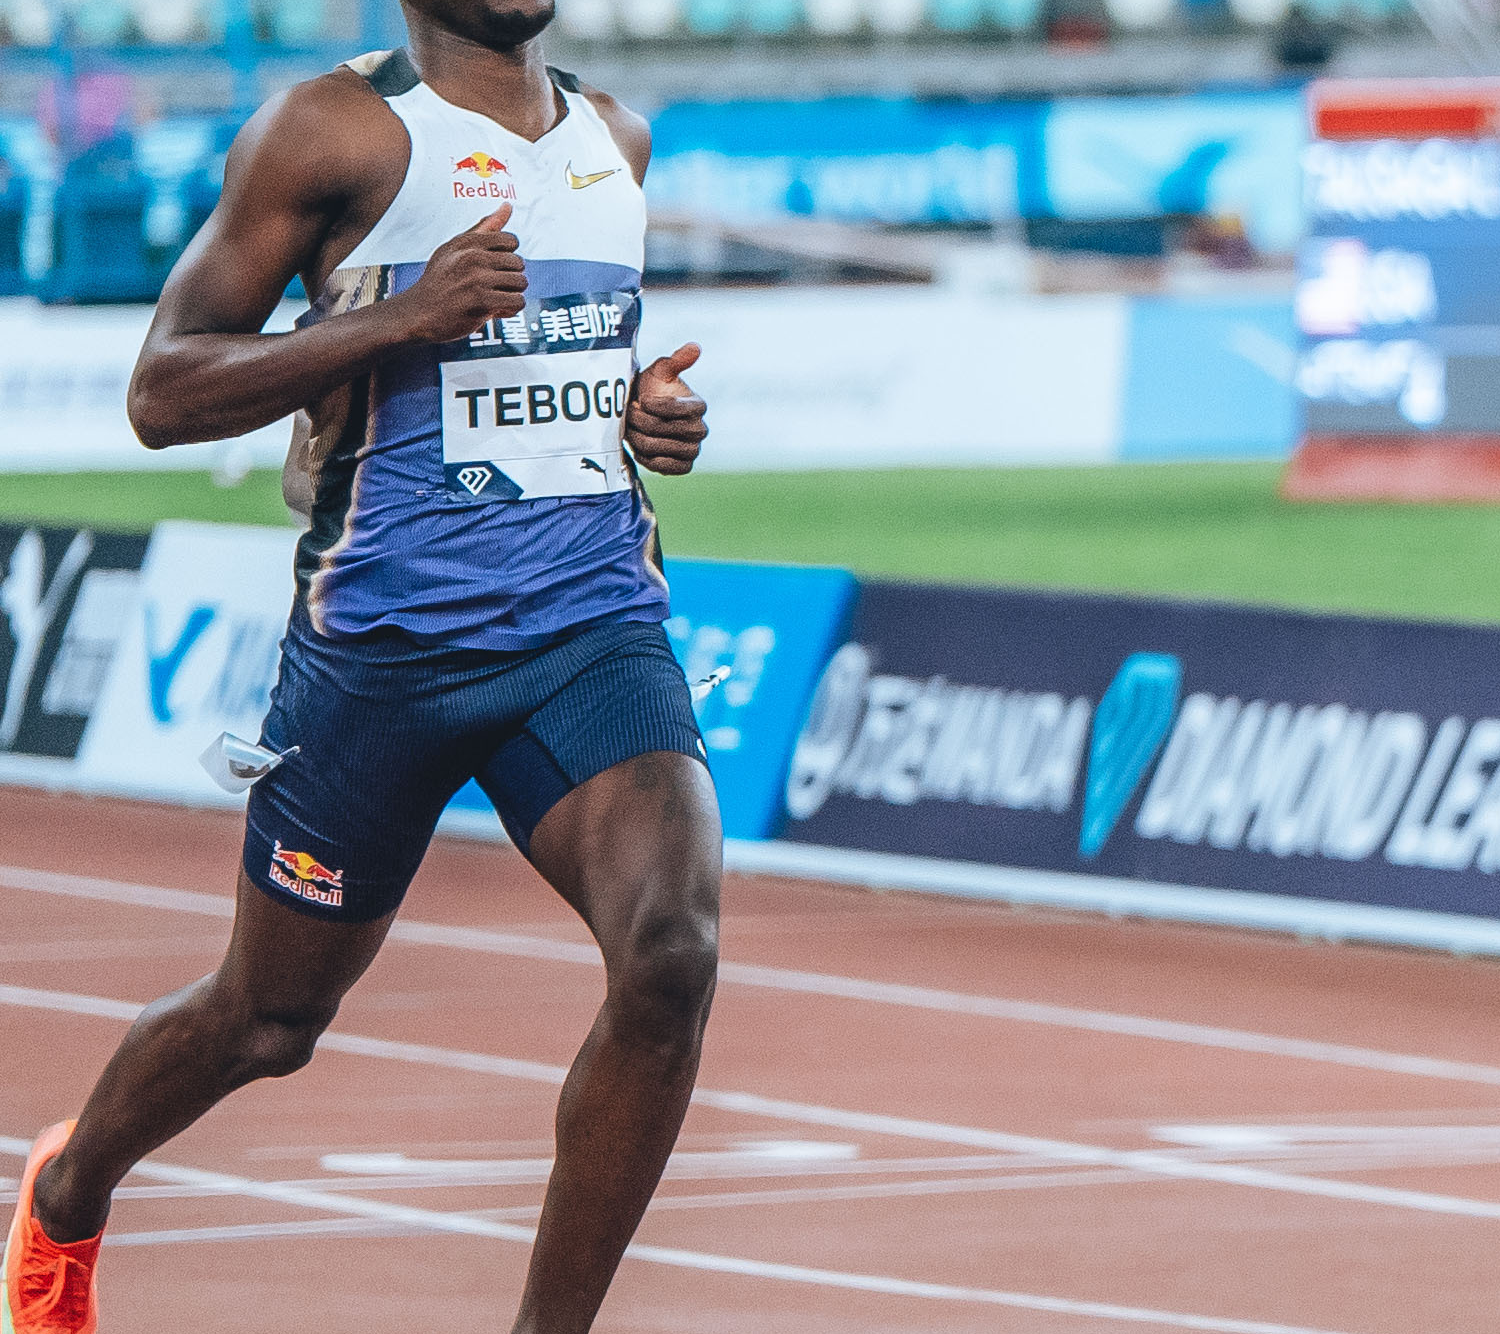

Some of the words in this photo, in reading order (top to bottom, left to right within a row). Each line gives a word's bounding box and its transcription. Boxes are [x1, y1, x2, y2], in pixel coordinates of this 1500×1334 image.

[453, 181, 488, 199] Red
[488, 182, 517, 200] Bull
[454, 377, 627, 429] TEBOGO
[1134, 691, 1426, 863] DIAMOND
[269, 861, 302, 895] Red
[302, 881, 342, 906] Bull
